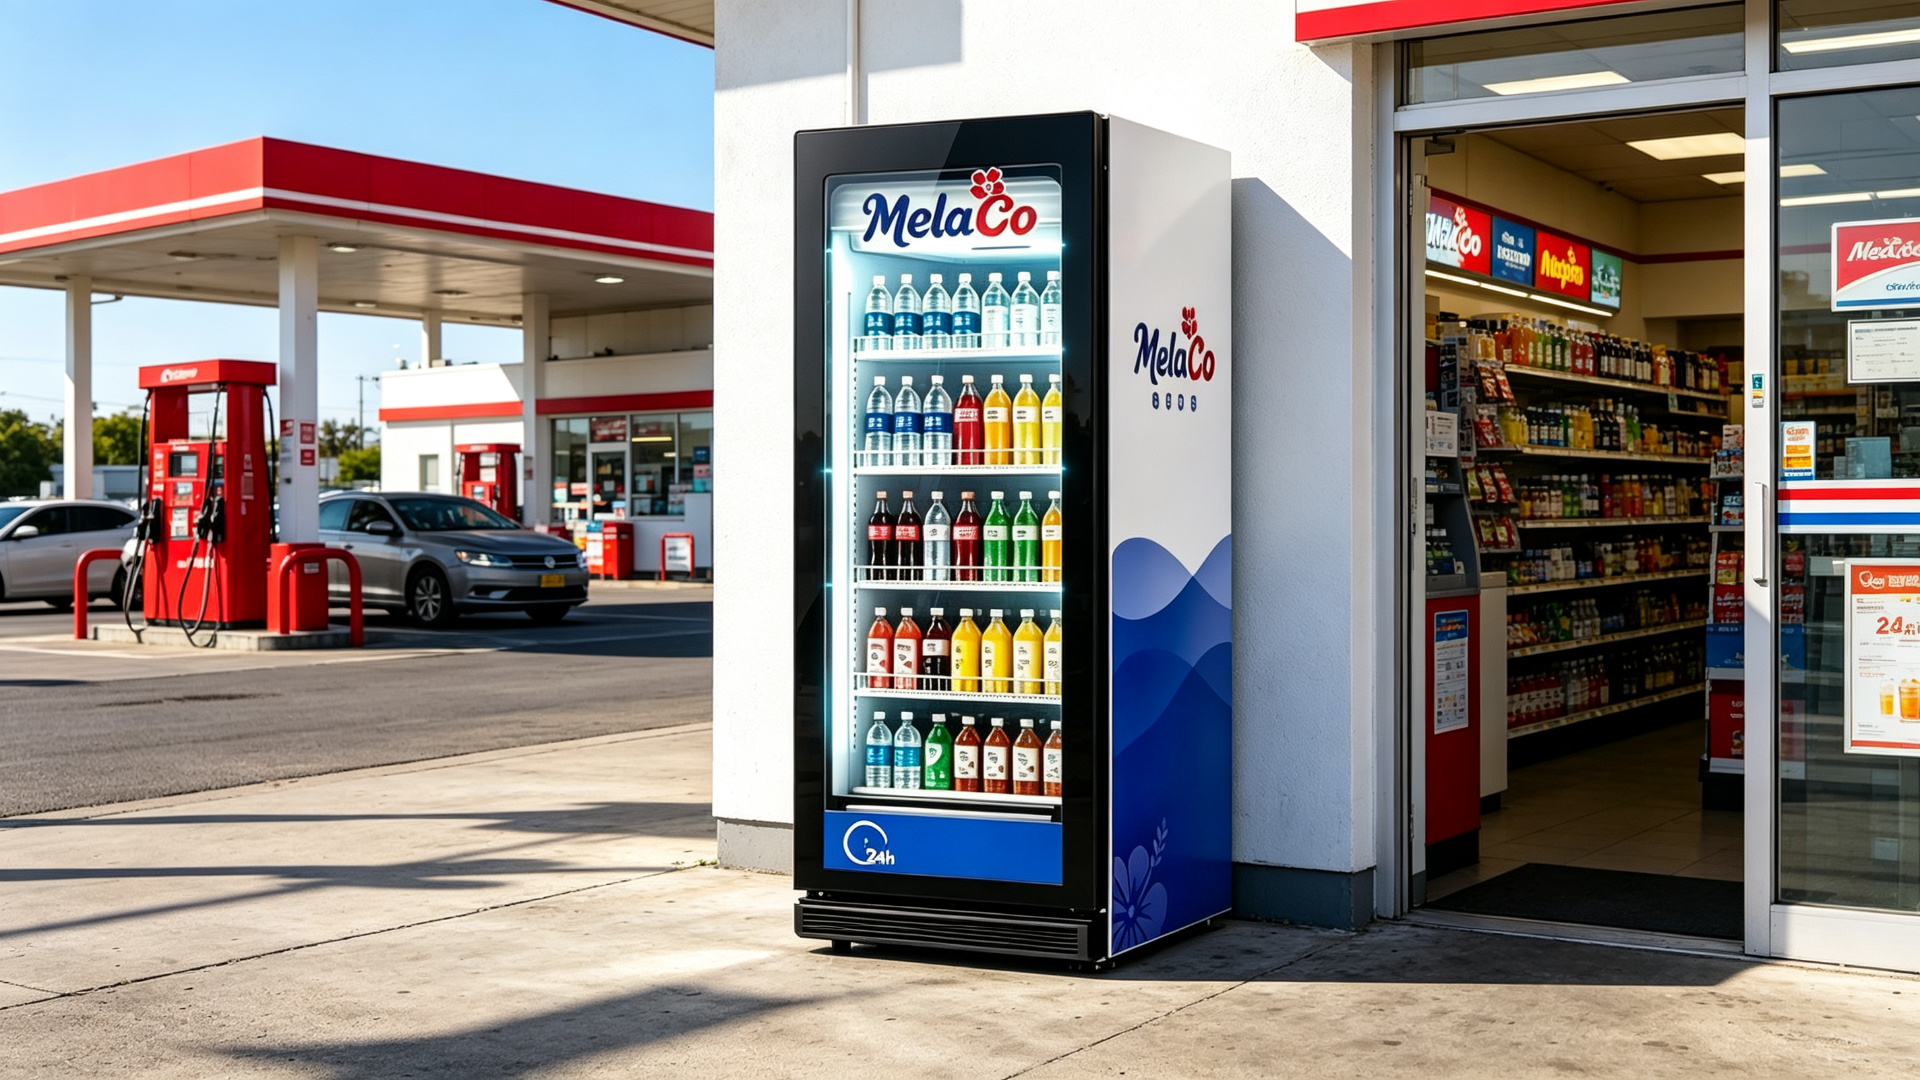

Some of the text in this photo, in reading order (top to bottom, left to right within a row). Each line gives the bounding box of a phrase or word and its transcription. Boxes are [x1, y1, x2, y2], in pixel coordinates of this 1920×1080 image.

[862, 192, 1038, 248] MelaCo
[1134, 322, 1215, 386] MelaCo
[865, 847, 896, 866] 24h
